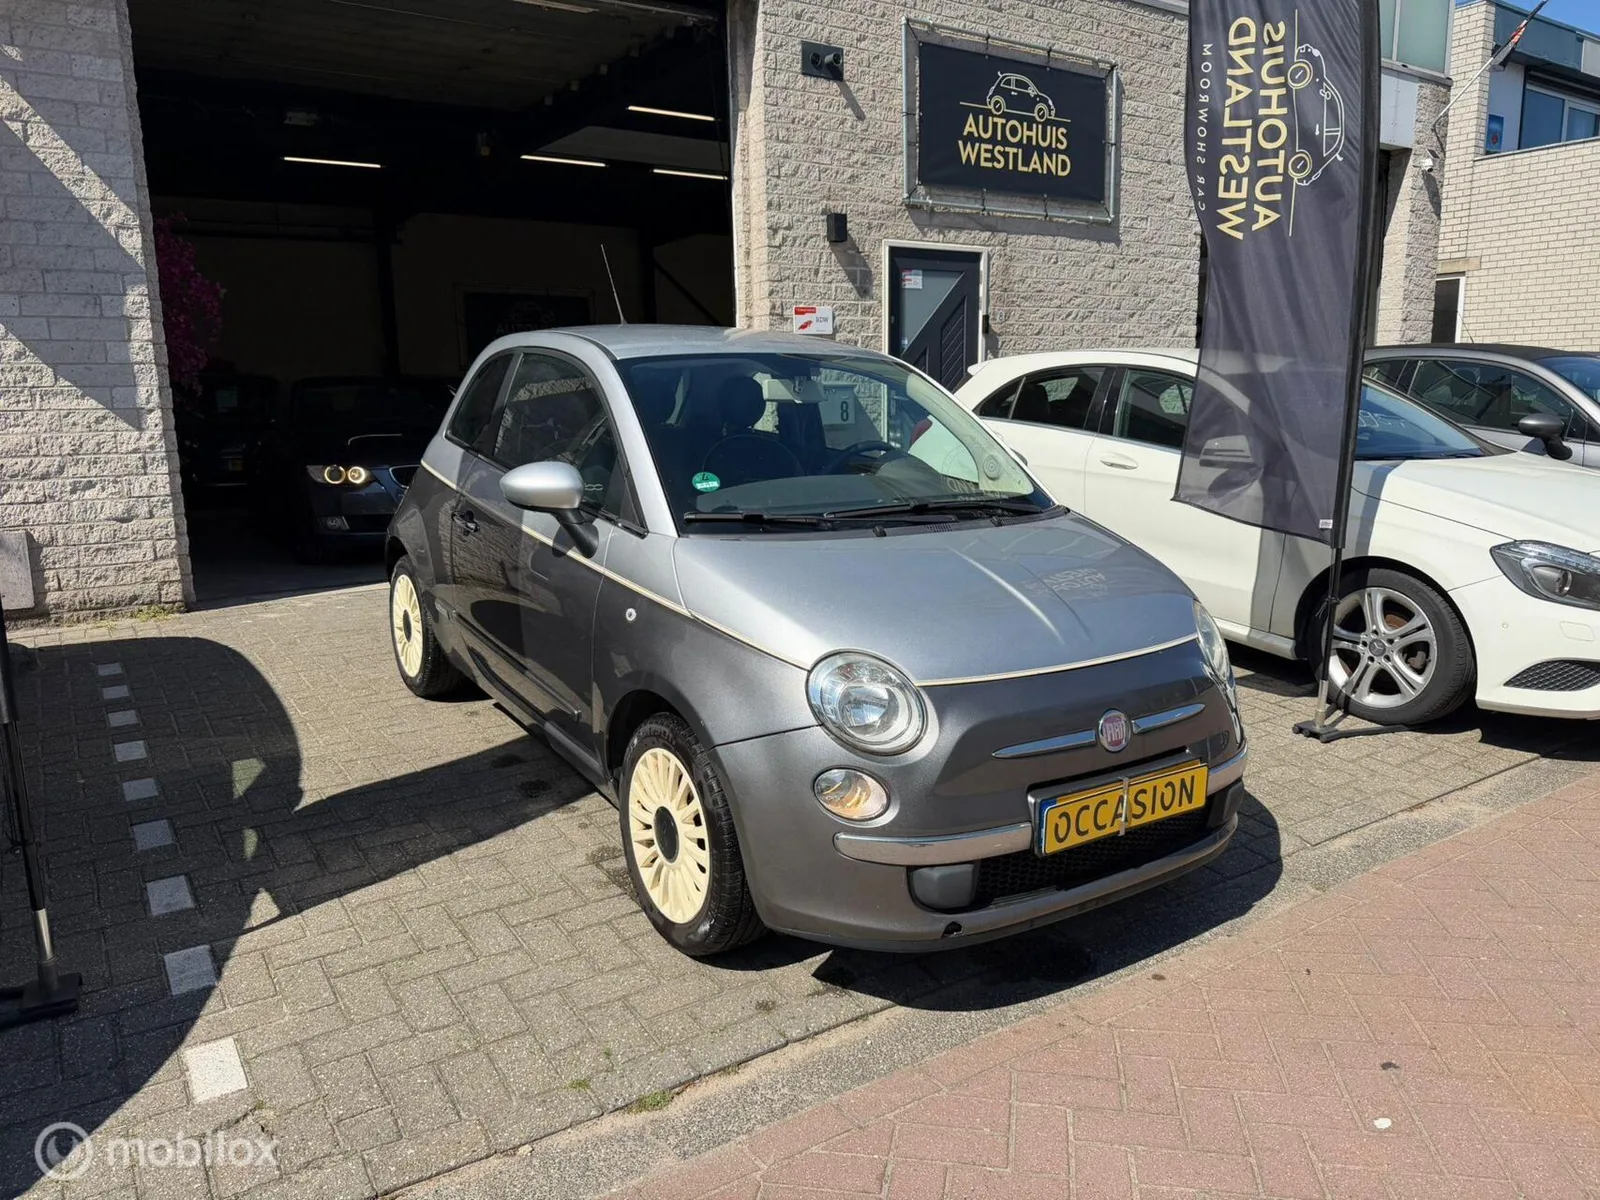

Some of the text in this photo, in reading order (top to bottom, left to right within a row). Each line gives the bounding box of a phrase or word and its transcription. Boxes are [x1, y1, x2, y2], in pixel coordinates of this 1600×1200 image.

[963, 112, 1067, 150] AUTOHUIS
[958, 140, 1071, 177] WESTLAND
[840, 400, 849, 422] 8
[1054, 775, 1196, 843] OCCASION
